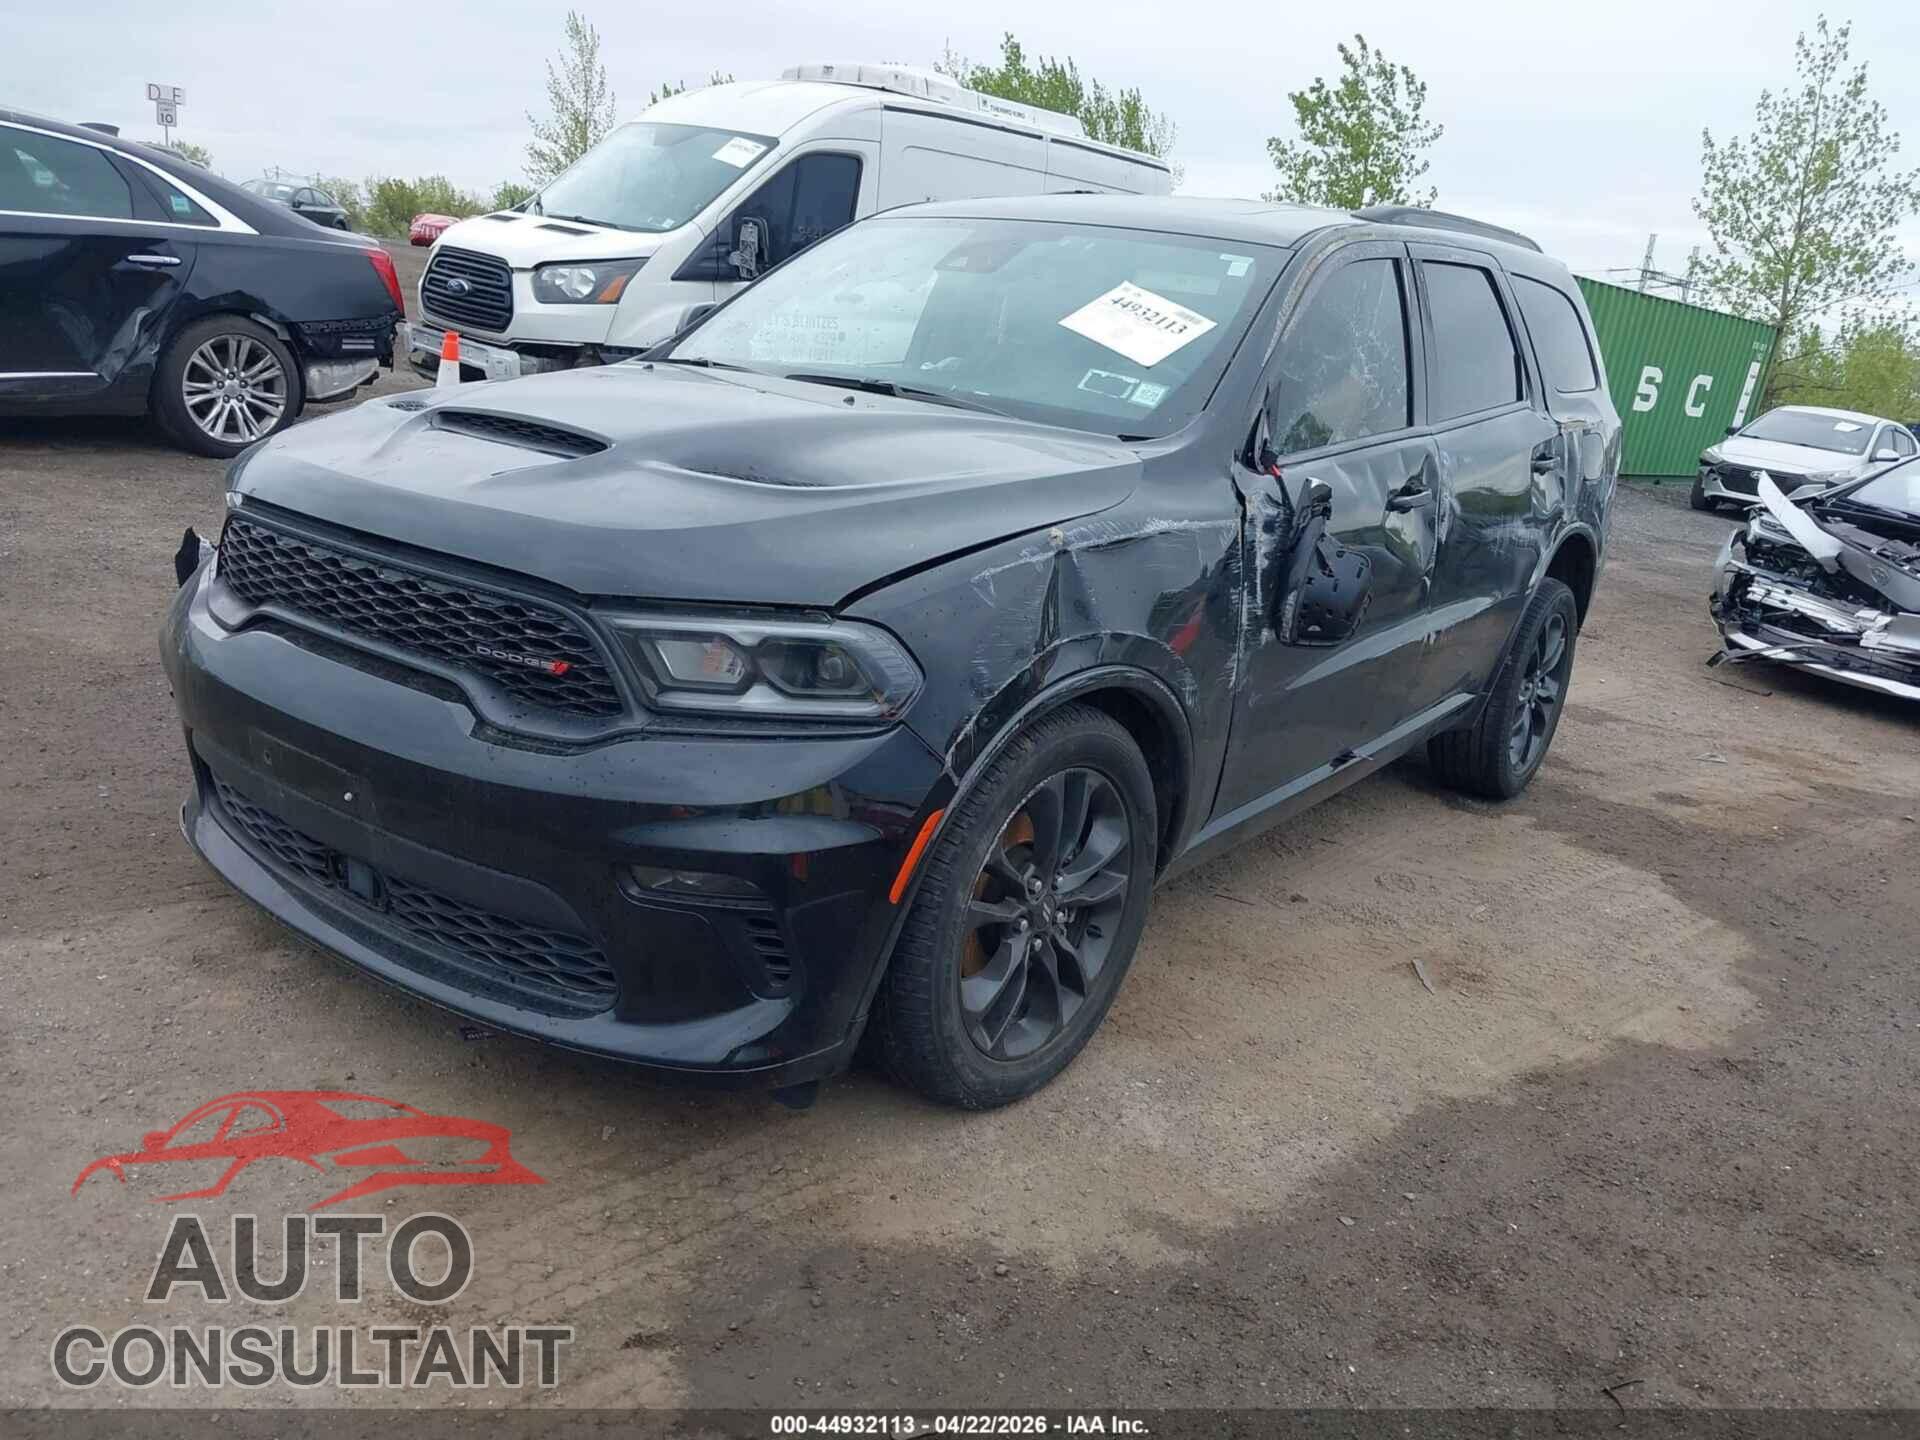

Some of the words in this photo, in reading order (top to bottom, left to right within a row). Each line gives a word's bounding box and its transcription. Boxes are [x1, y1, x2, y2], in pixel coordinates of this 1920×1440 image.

[160, 113, 173, 123] 10
[1110, 296, 1188, 335] 44932113
[1632, 365, 1664, 412] S
[1684, 374, 1714, 418] C
[476, 645, 555, 671] DODGE
